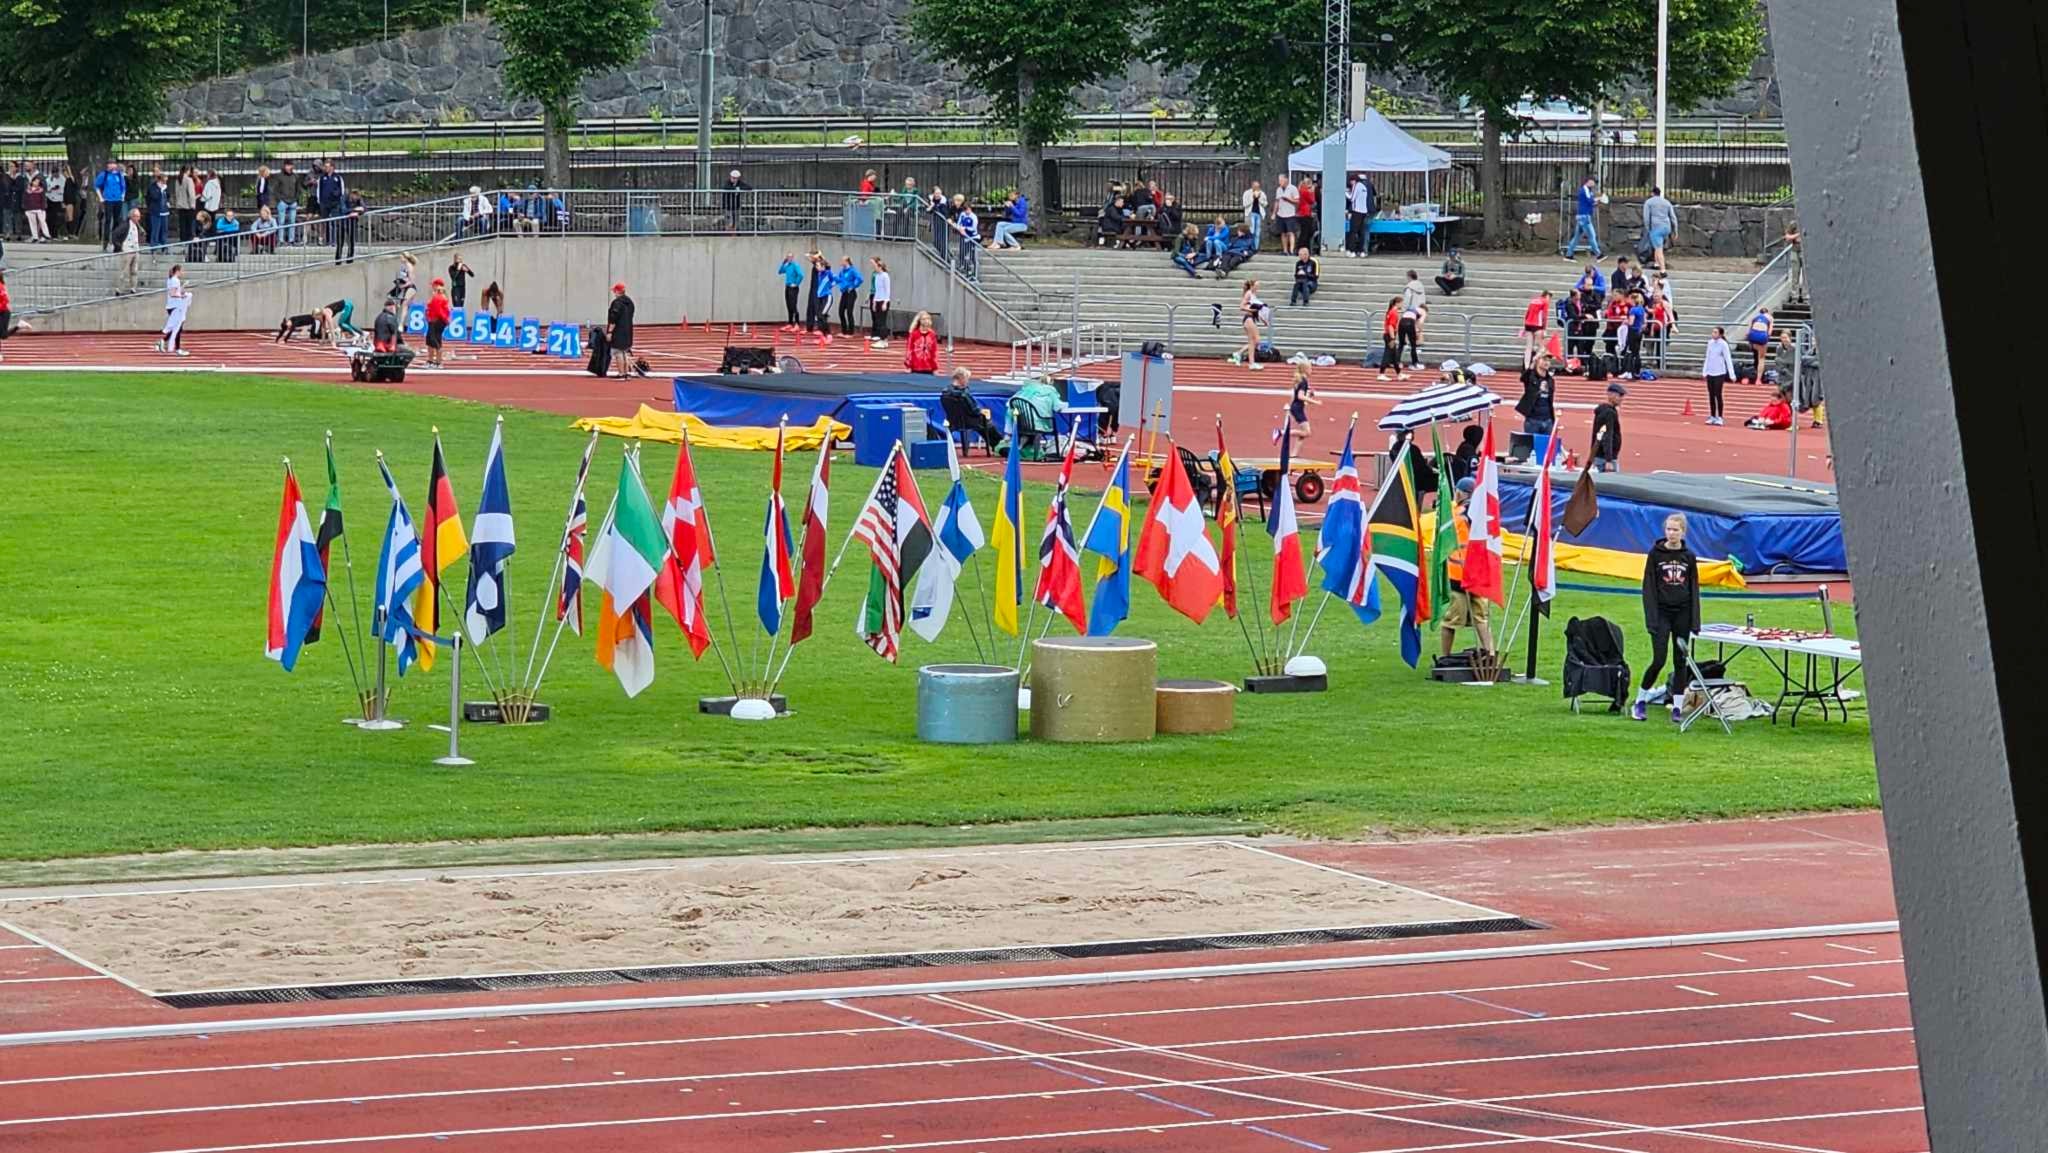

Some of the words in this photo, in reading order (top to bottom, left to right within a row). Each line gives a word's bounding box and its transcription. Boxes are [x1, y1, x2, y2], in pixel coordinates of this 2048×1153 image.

[409, 310, 425, 331] 8
[453, 316, 464, 338] 6
[475, 319, 488, 341] 5
[498, 322, 513, 344] 4
[523, 325, 538, 348] 3
[550, 329, 564, 352] 2
[563, 332, 573, 356] 1
